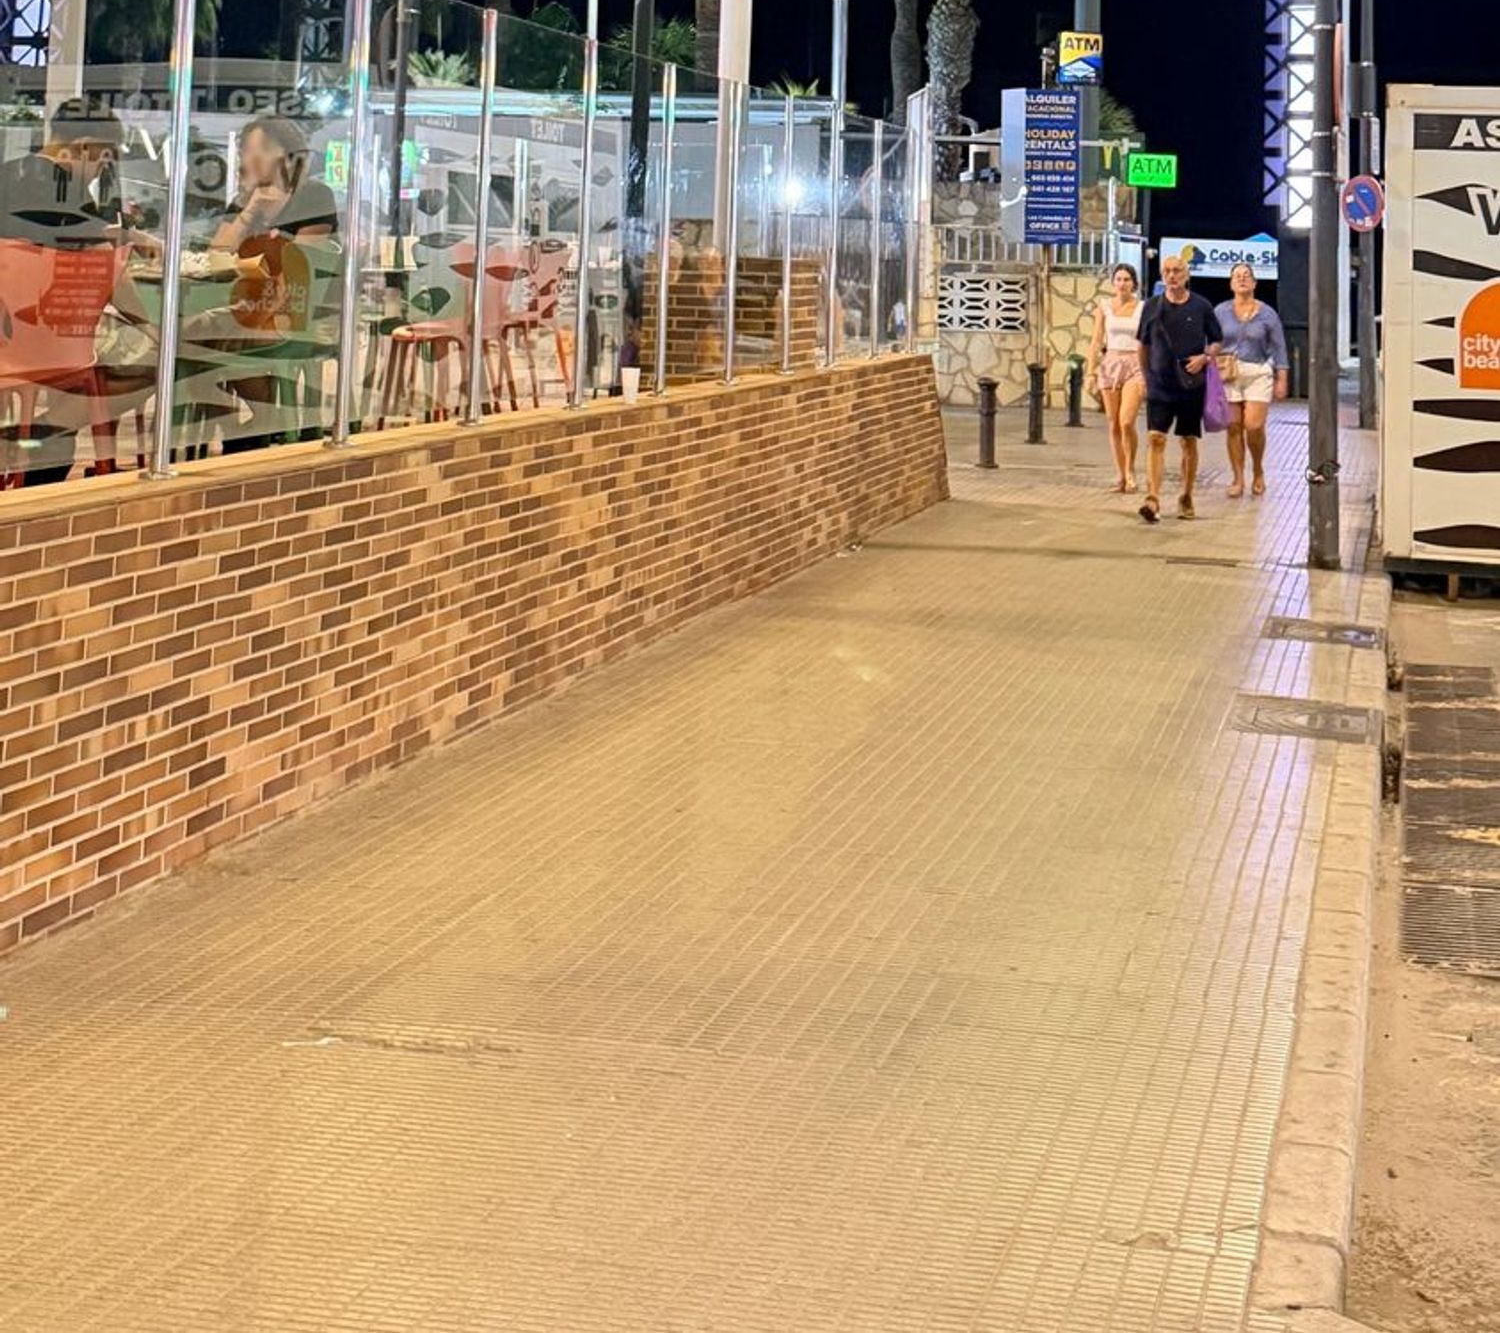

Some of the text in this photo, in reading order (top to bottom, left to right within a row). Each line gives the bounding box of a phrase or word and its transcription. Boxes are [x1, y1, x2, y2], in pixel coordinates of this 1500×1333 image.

[1064, 37, 1100, 51] ATM
[1025, 105, 1076, 114] ACACIONAL
[1025, 129, 1076, 140] HOLIDAY
[1131, 158, 1172, 175] ATM
[1463, 333, 1500, 357] city
[1464, 350, 1500, 369] bea
